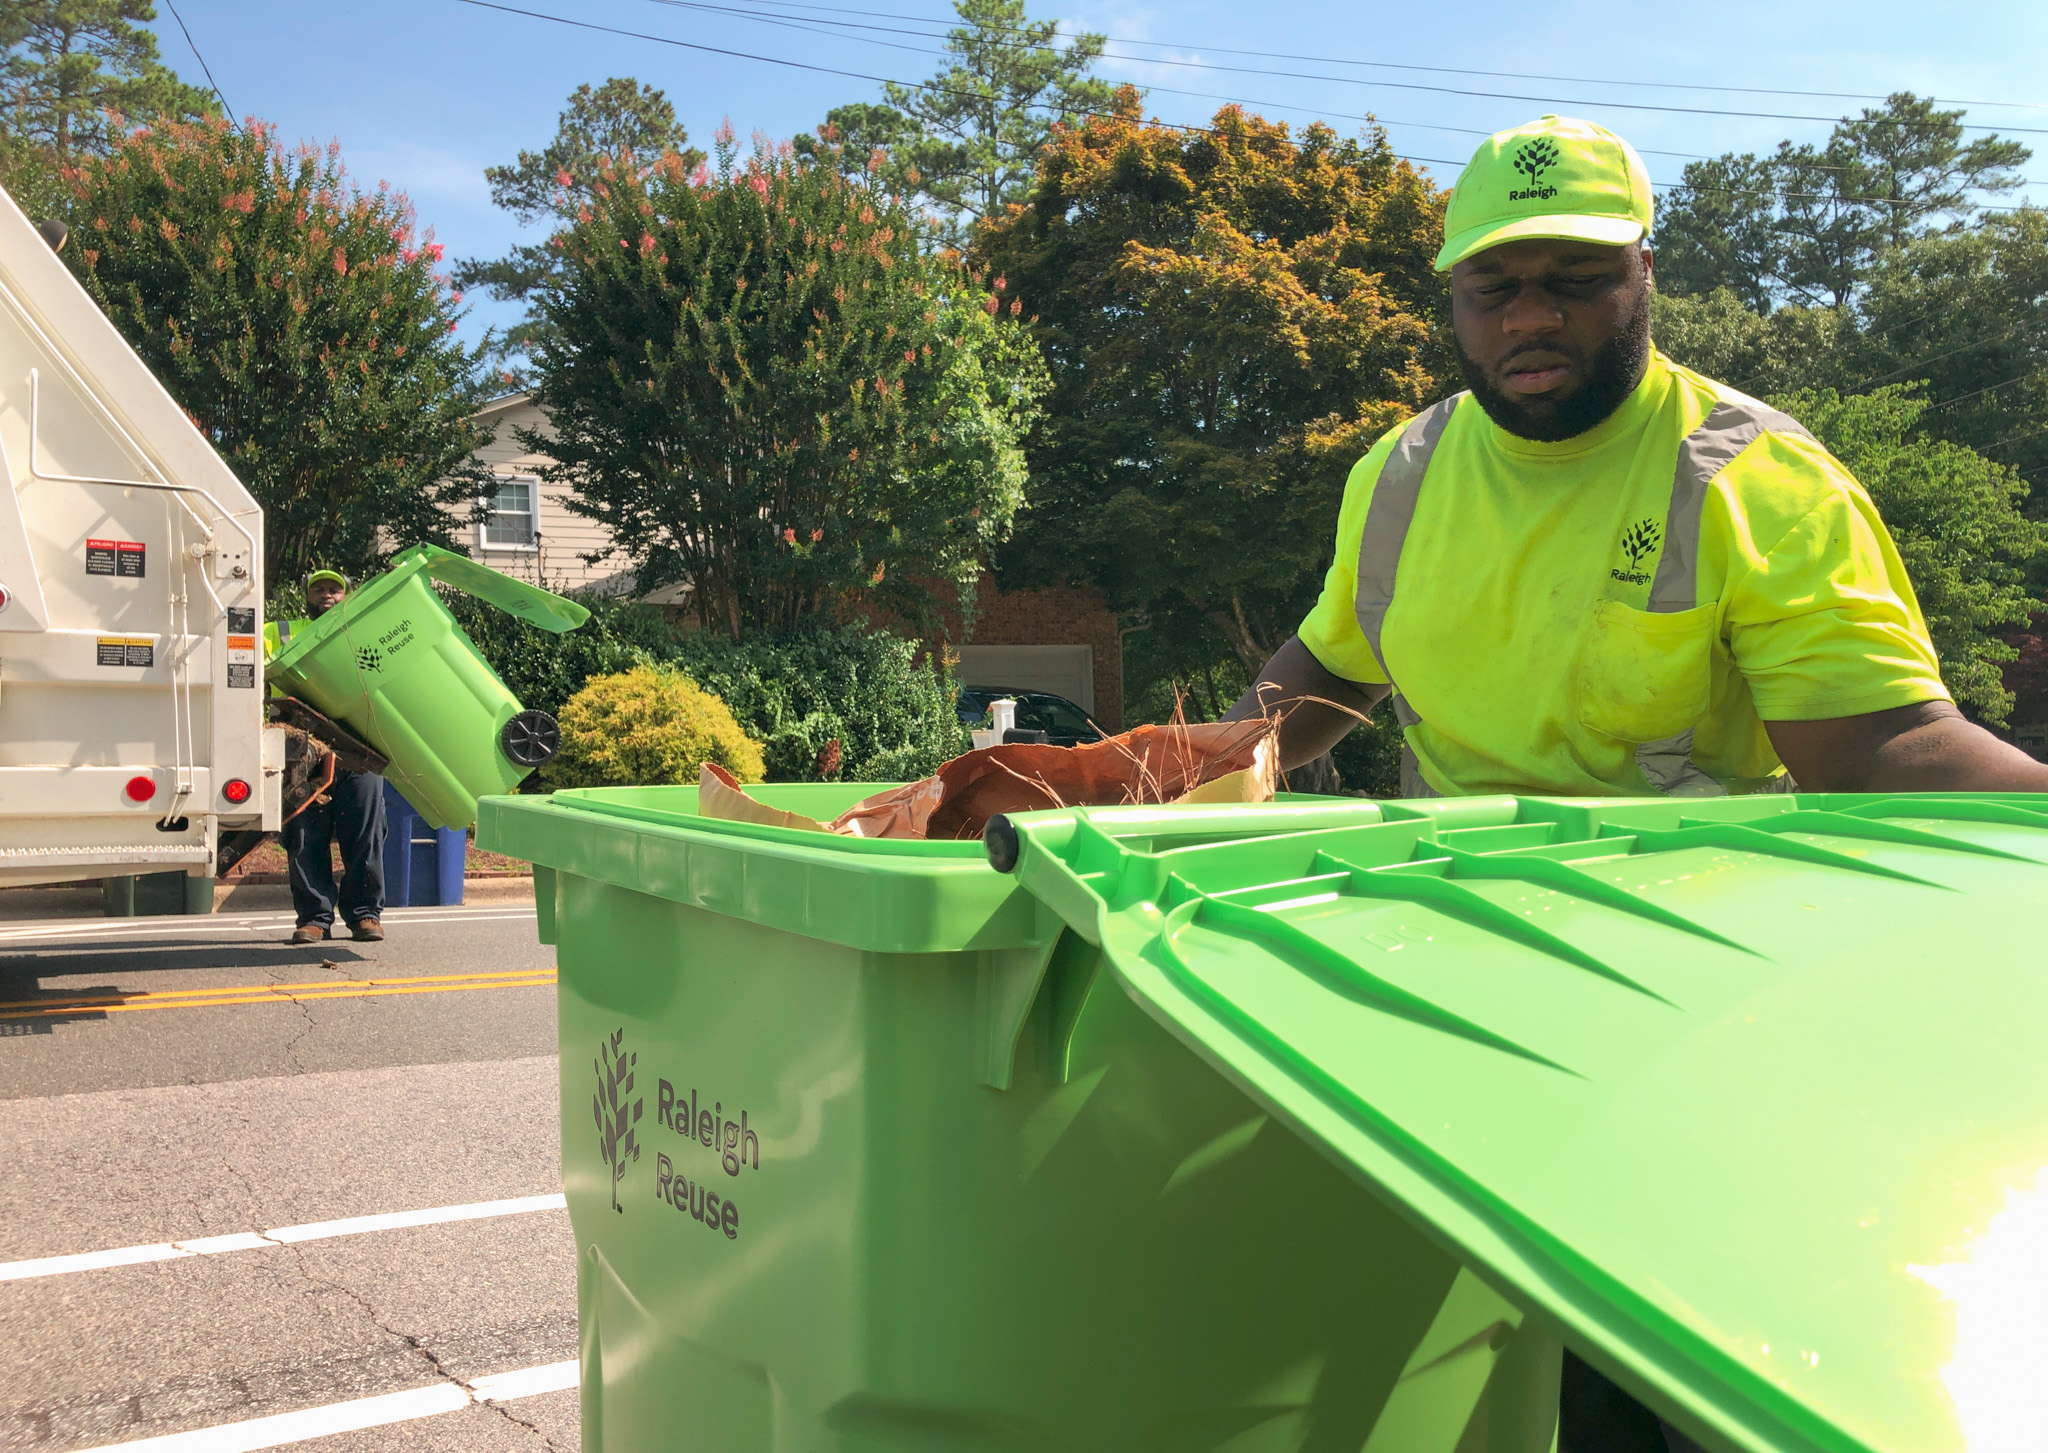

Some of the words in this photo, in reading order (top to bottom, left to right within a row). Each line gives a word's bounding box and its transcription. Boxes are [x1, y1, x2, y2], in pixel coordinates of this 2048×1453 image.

[1509, 185, 1558, 201] Raleigh
[1610, 568, 1652, 586] Raleigh
[378, 619, 412, 646] Raleigh
[387, 633, 415, 655] Reuse
[658, 1077, 759, 1177] Raleigh
[656, 1151, 739, 1240] Reuse
